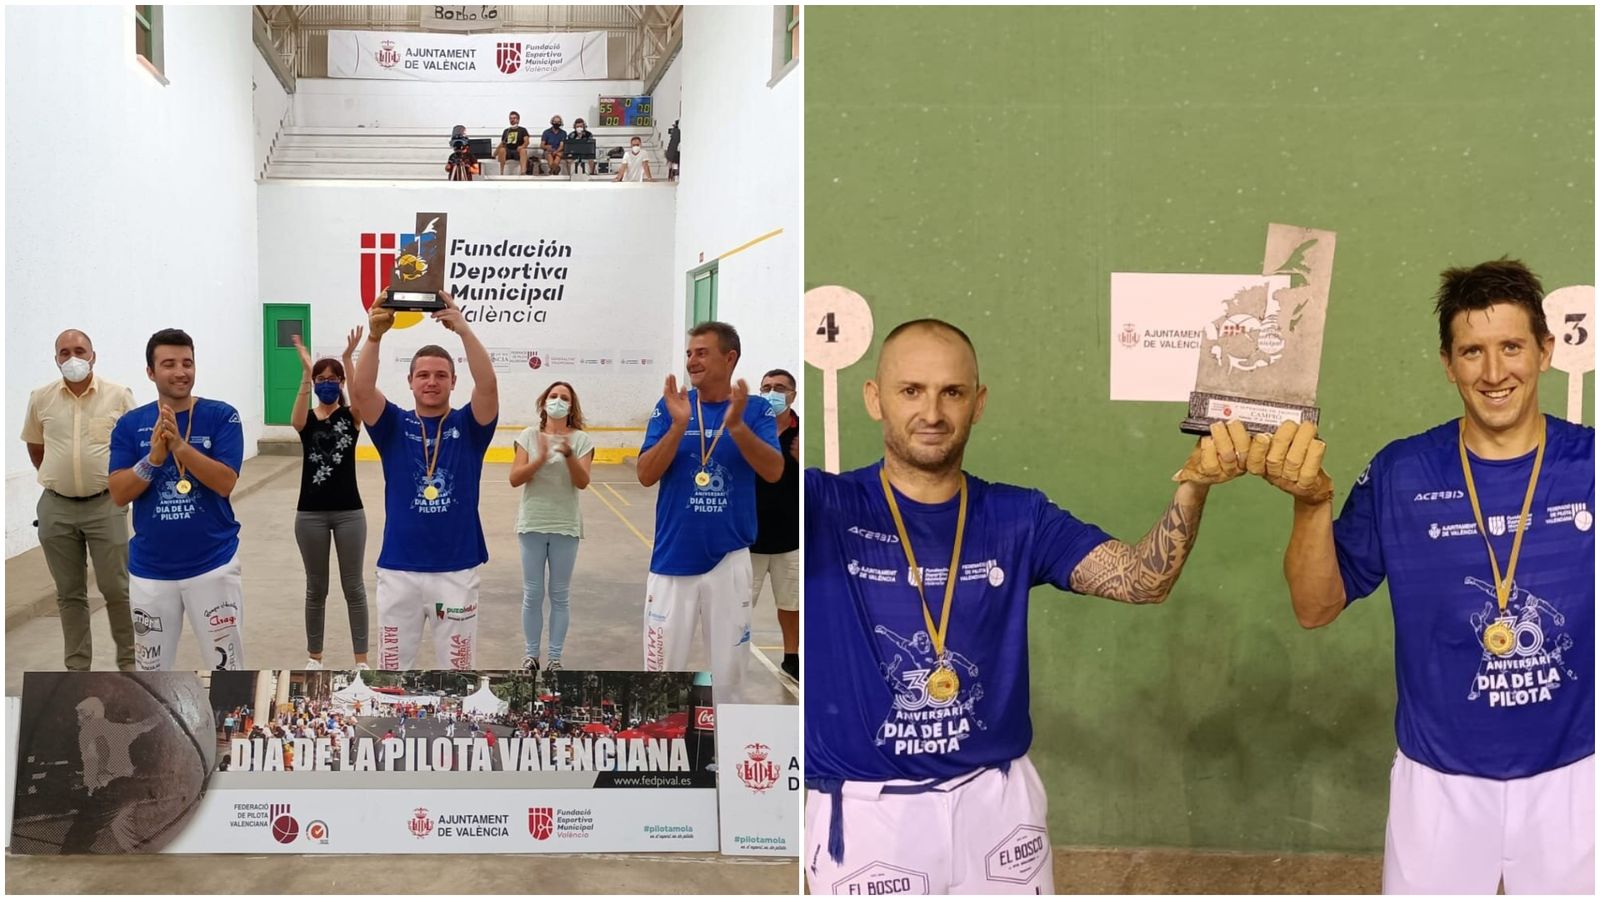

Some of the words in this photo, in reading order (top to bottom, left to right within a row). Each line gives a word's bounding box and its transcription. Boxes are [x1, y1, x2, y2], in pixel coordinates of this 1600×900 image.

[406, 48, 477, 59] AJUNTAMENT
[525, 51, 562, 59] Esportiva
[405, 60, 419, 69] DE
[424, 60, 476, 71] VALÈNCIA
[525, 58, 563, 66] Municipal
[450, 238, 572, 258] Fundación
[450, 262, 568, 284] Deportiva
[450, 284, 564, 306] Municipal
[816, 312, 840, 343] 4
[1563, 313, 1588, 346] 3
[1143, 340, 1157, 349] DE
[441, 497, 451, 505] LA
[690, 497, 704, 505] DIA
[706, 497, 717, 505] DE
[718, 497, 728, 505] LA
[171, 505, 182, 513] DE
[184, 504, 195, 512] LA
[419, 505, 447, 513] PILOTA
[694, 505, 723, 513] PILOTA
[160, 512, 191, 520] PILOTA
[384, 626, 398, 644] BAR
[1487, 656, 1550, 670] ANIVERSARI
[1477, 674, 1509, 690] DIA
[1512, 671, 1534, 689] DE
[1537, 667, 1560, 685] LA
[1489, 687, 1552, 708] PILOTA
[884, 723, 917, 738] DIA
[920, 722, 942, 739] DE
[947, 718, 970, 736] LA
[895, 738, 960, 755] PILOTA
[231, 738, 284, 772] DIA
[294, 738, 332, 772] DE
[340, 738, 376, 772] LA
[384, 738, 492, 772] PILOTA
[498, 738, 690, 772] VALENCIANA
[614, 775, 692, 788] www.fedpival.es
[234, 803, 269, 811] FEDERACIÓ
[438, 814, 509, 825] AJUNTAMENT
[438, 827, 452, 837] DE
[456, 825, 509, 837] VALÈNCIA
[557, 824, 594, 832] Municipal
[644, 825, 693, 833] #pilotamola
[557, 831, 589, 839] València
[734, 836, 786, 844] #pilotamola
[1000, 850, 1013, 866] EL
[1014, 836, 1043, 861] BOSCO
[867, 877, 911, 895] BOSCO
